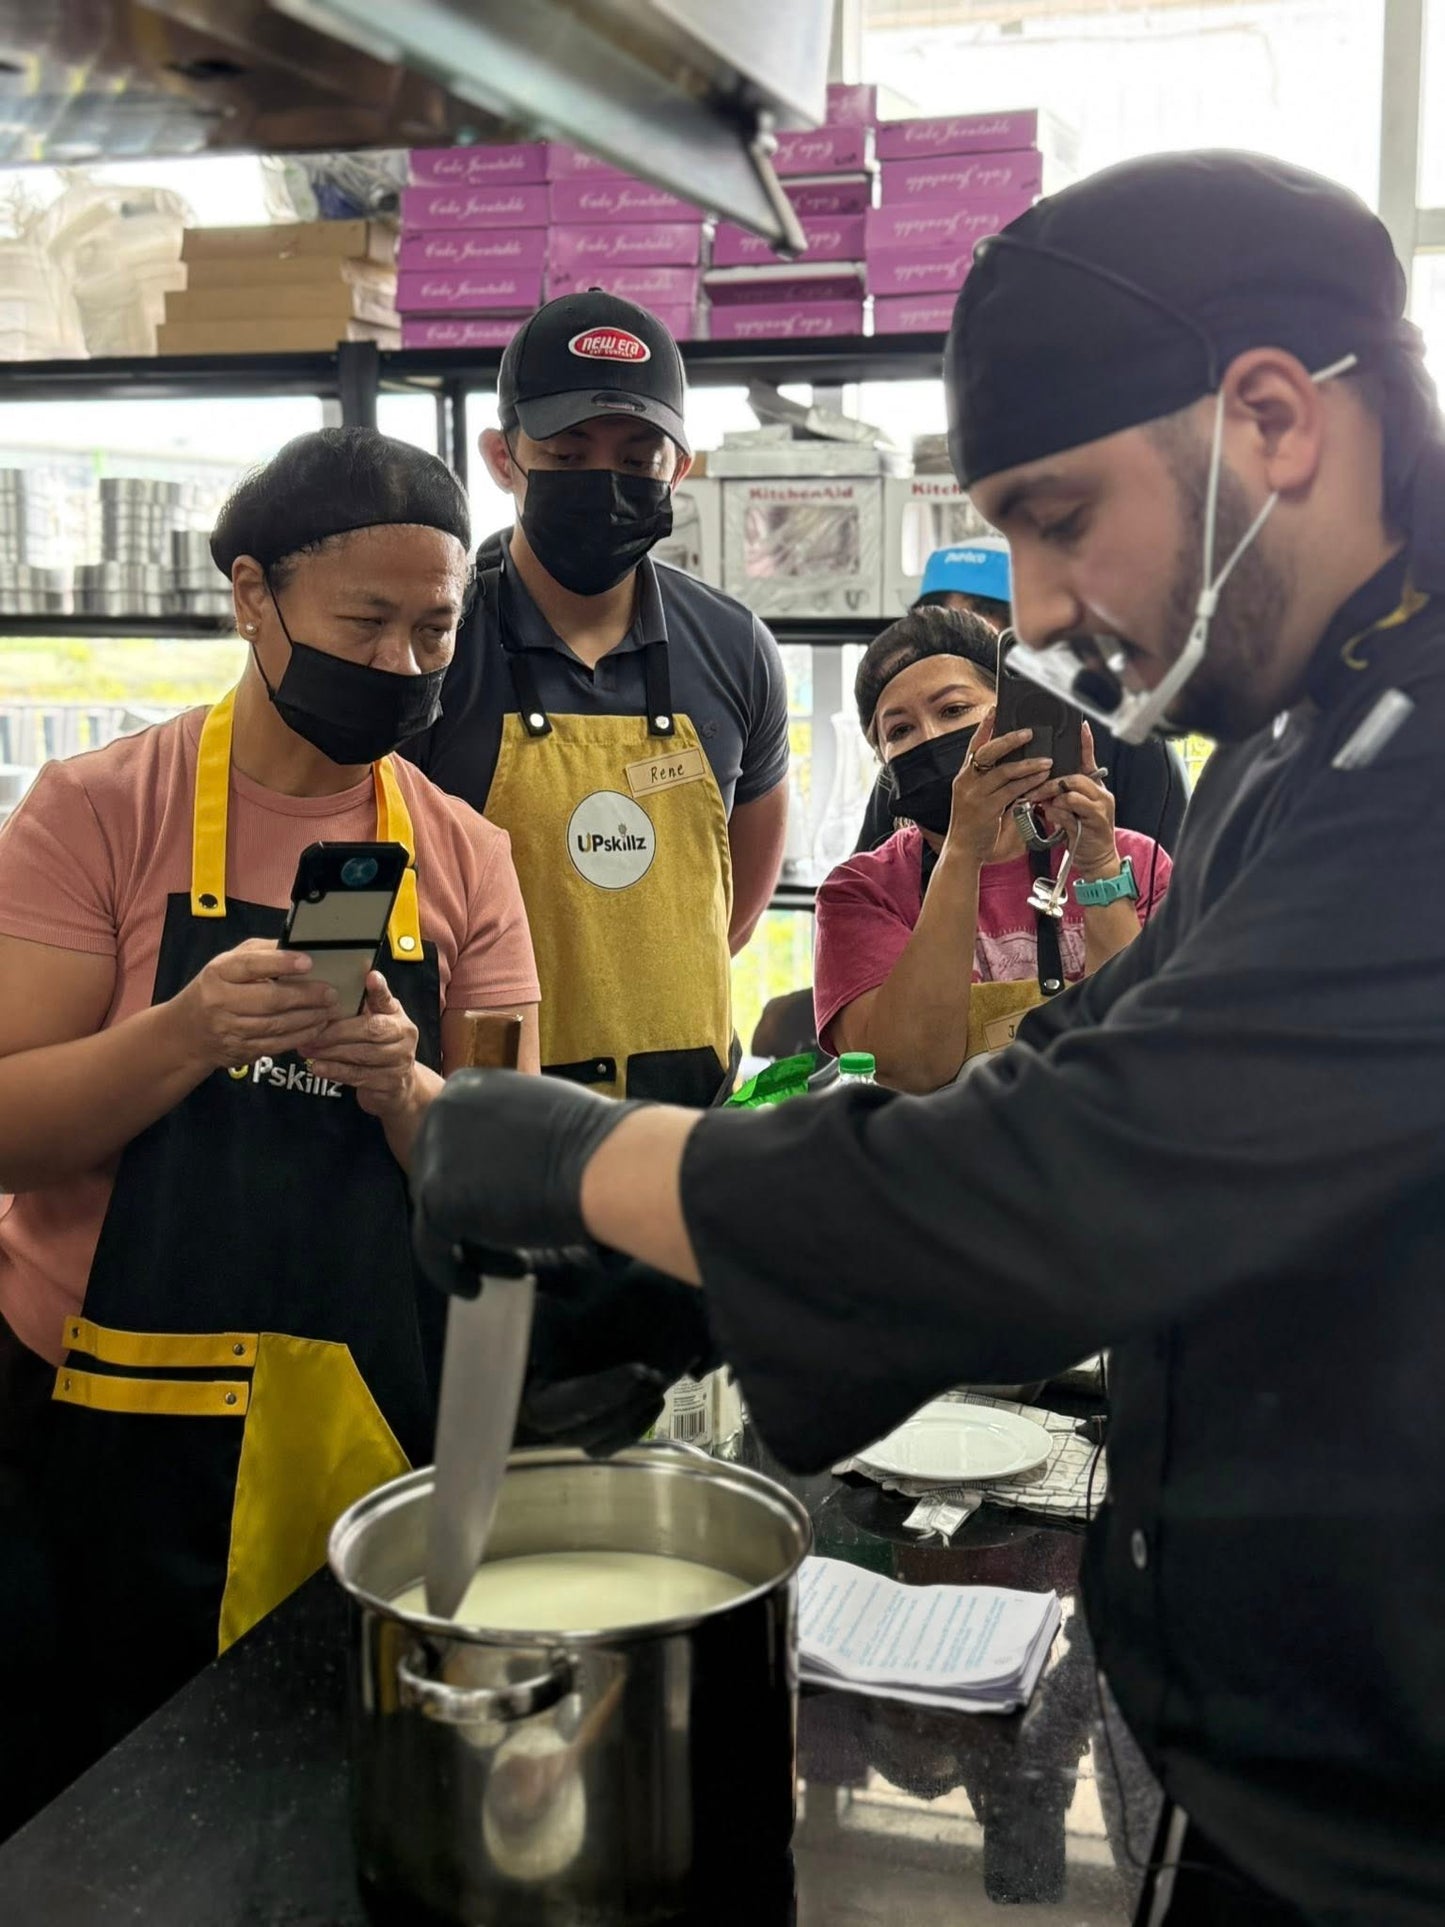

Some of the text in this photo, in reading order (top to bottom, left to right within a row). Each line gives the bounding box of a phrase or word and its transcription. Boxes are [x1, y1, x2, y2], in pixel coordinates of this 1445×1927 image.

[750, 486, 853, 500] KitchenAid
[650, 763, 685, 783] Rene
[577, 830, 647, 854] UPskillz
